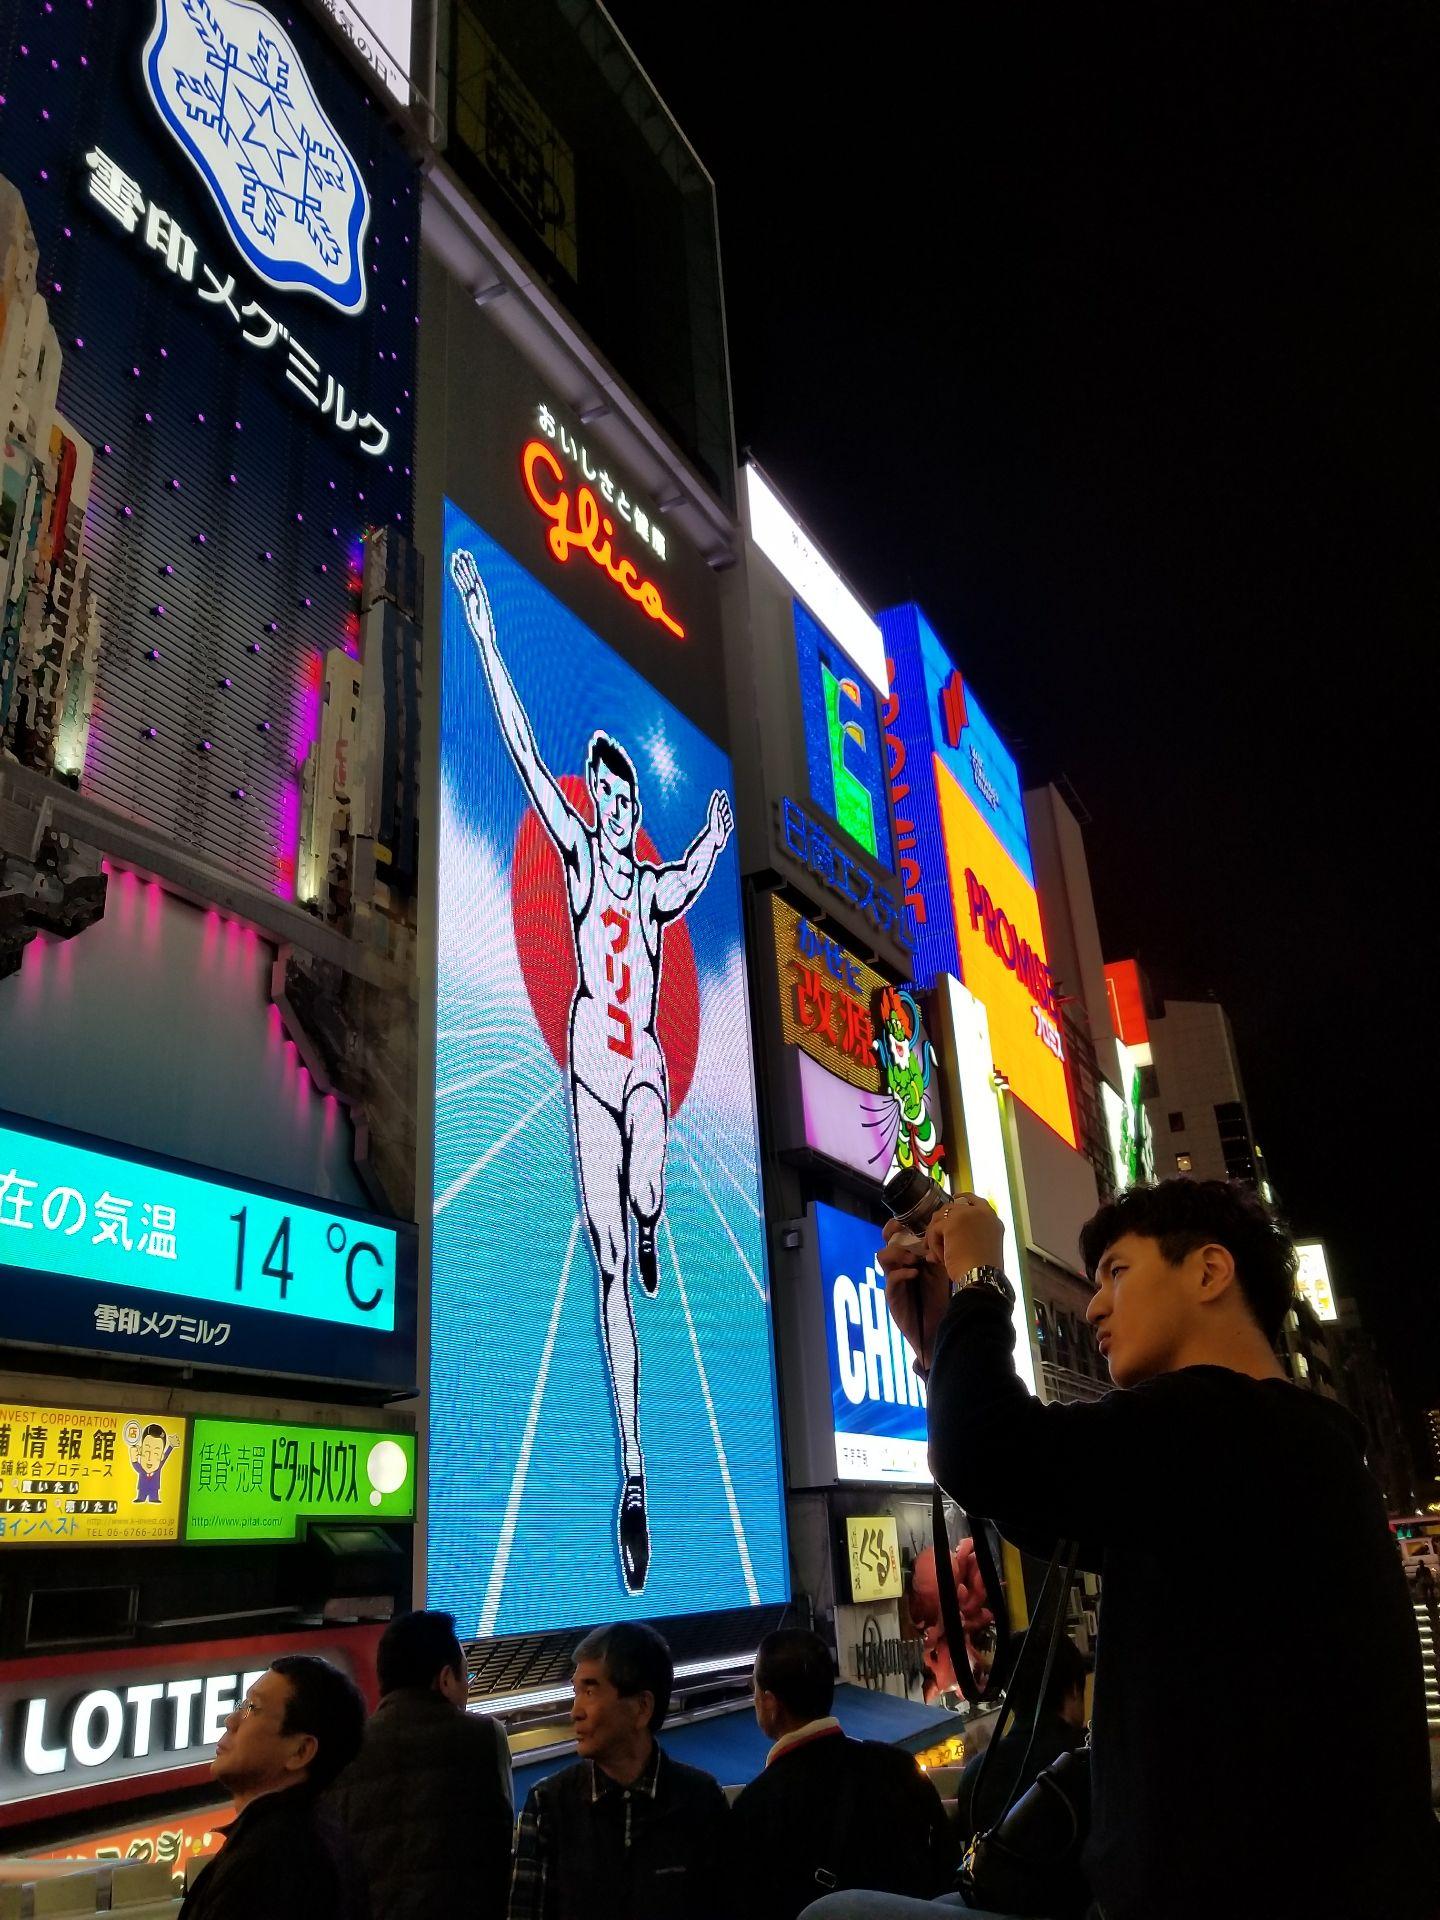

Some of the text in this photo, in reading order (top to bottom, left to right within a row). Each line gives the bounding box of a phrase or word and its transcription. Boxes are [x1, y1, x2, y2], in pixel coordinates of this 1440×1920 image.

[85, 145, 391, 456] 雪印メグミルク
[523, 440, 685, 640] Glico
[600, 905, 634, 1061] グリコ
[964, 867, 1060, 1023] PROMISE
[0, 1168, 178, 1260] 在の気温
[229, 1206, 294, 1299] 14
[94, 1303, 232, 1346] 雪印メグミルク
[833, 1272, 928, 1406] CHI
[41, 1412, 118, 1429] CORPORATION
[269, 1436, 359, 1504] ピタットハウス
[87, 1528, 174, 1537] TEL 06-6766-2016
[24, 1671, 268, 1775] LOTTE
